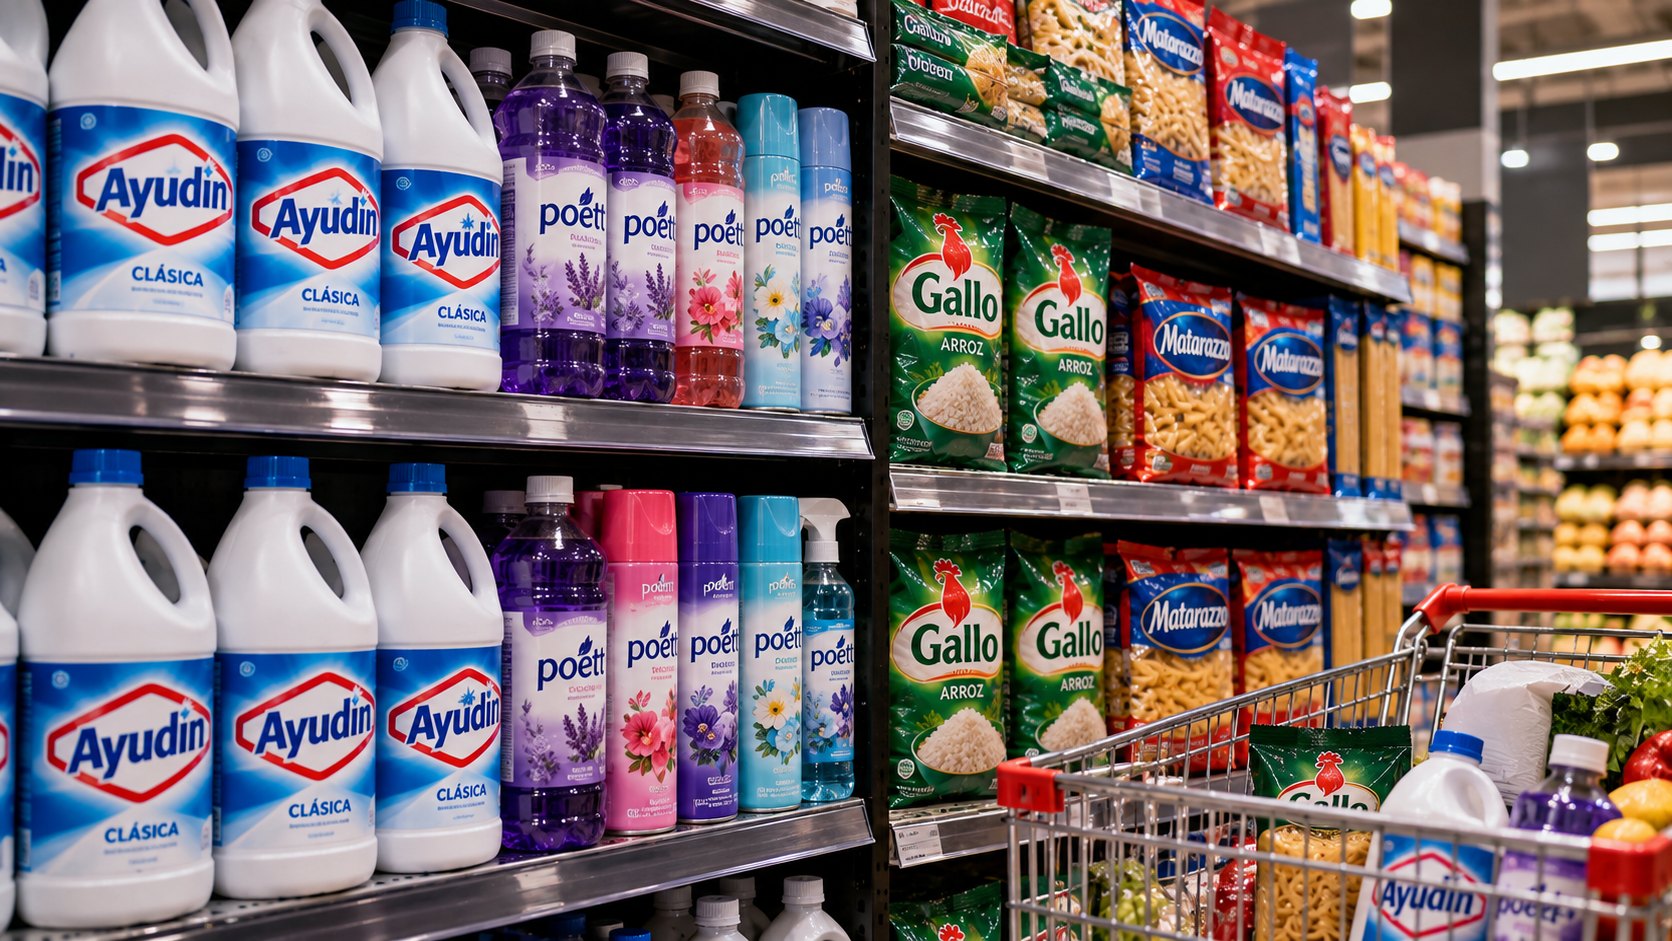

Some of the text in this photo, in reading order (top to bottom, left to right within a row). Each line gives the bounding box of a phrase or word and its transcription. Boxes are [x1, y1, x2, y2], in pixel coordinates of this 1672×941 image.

[96, 165, 227, 218] Ayudin
[269, 196, 377, 246] Ayudin
[132, 263, 203, 288] CLÁSICA
[301, 285, 360, 307] CLÁSICA
[911, 270, 998, 323] Gallo
[437, 303, 487, 324] CLÁSICA
[1034, 299, 1104, 345] Gallo
[940, 337, 984, 356] ARROZ
[1160, 323, 1230, 361] Matarazzo
[1058, 358, 1093, 376] ARROZ
[1148, 600, 1228, 634] Matarazzo
[911, 623, 998, 666] Gallo
[1036, 620, 1102, 661] Gallo
[940, 683, 985, 700] ARROZ
[1060, 675, 1095, 692] ARROZ
[255, 693, 371, 759] Ayudin
[67, 707, 205, 780] Ayudin
[436, 783, 487, 802] CLÁSICA
[288, 797, 352, 819] CLÁSICA
[104, 820, 180, 844] CLÁSICA
